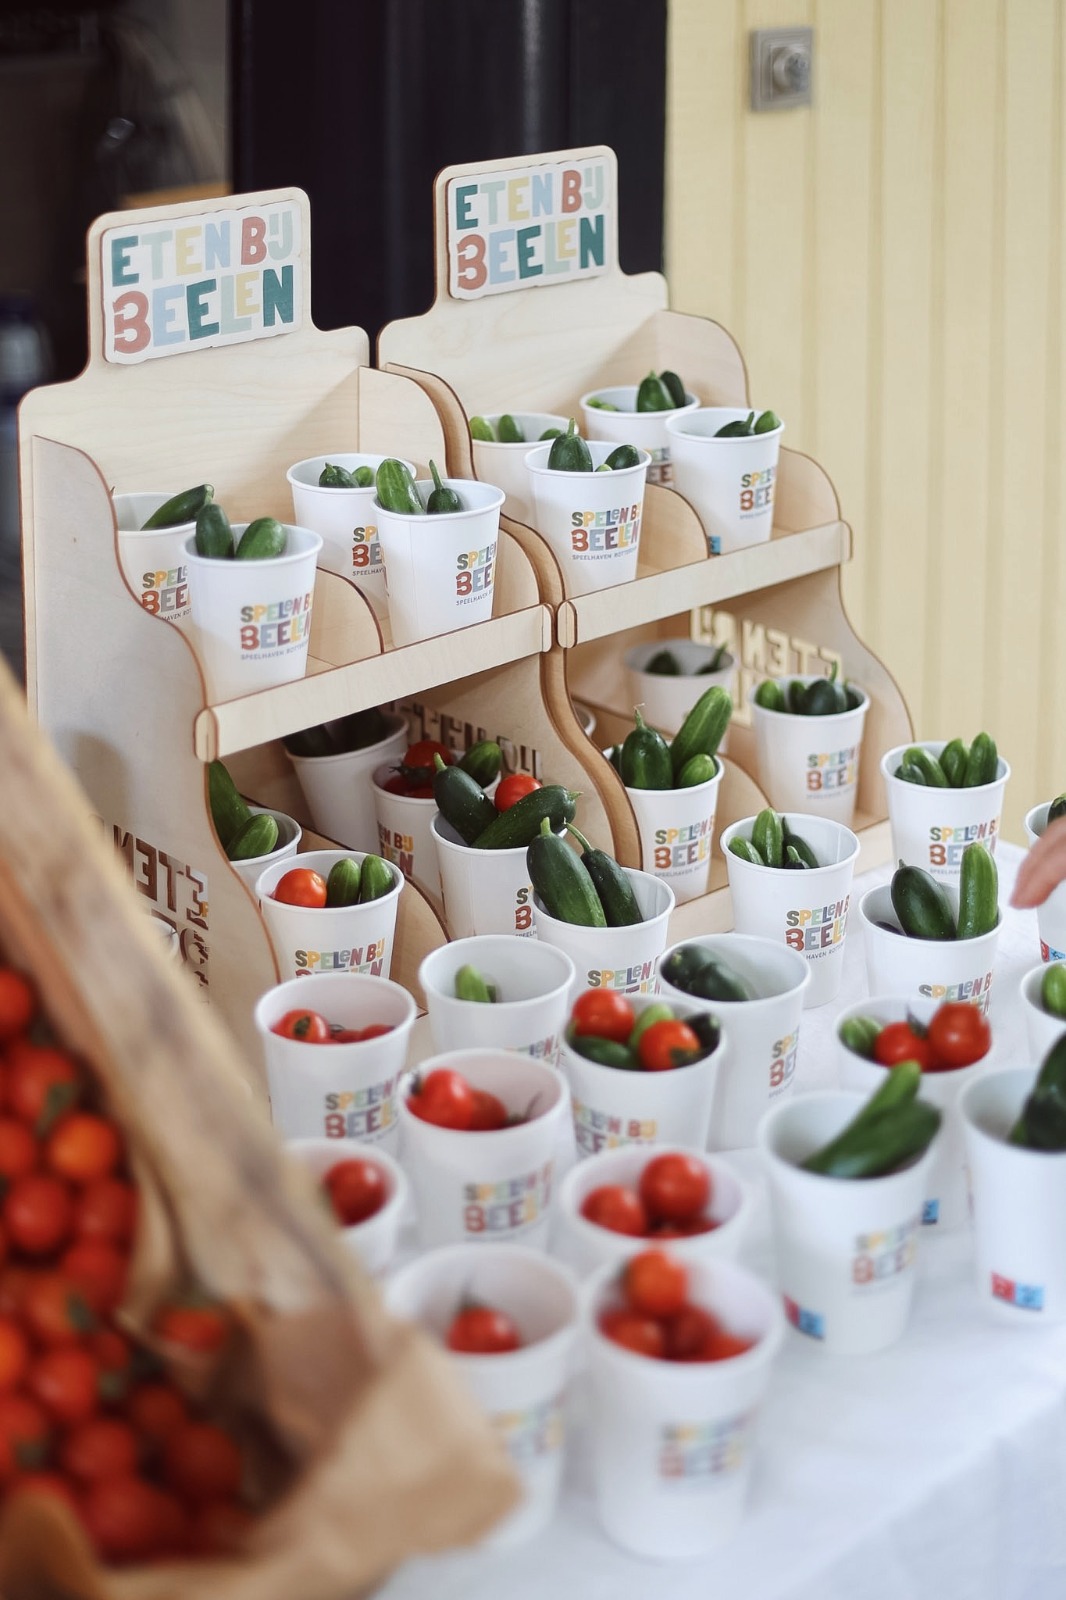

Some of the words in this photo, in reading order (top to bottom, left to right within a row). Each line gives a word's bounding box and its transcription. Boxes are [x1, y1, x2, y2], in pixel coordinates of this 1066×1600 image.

[455, 172, 554, 230] ETEN
[561, 165, 604, 214] BIJ
[111, 220, 231, 287] ETEN
[240, 210, 294, 266] BIJ
[457, 214, 604, 290] BEELEN
[112, 265, 294, 354] BEELEN
